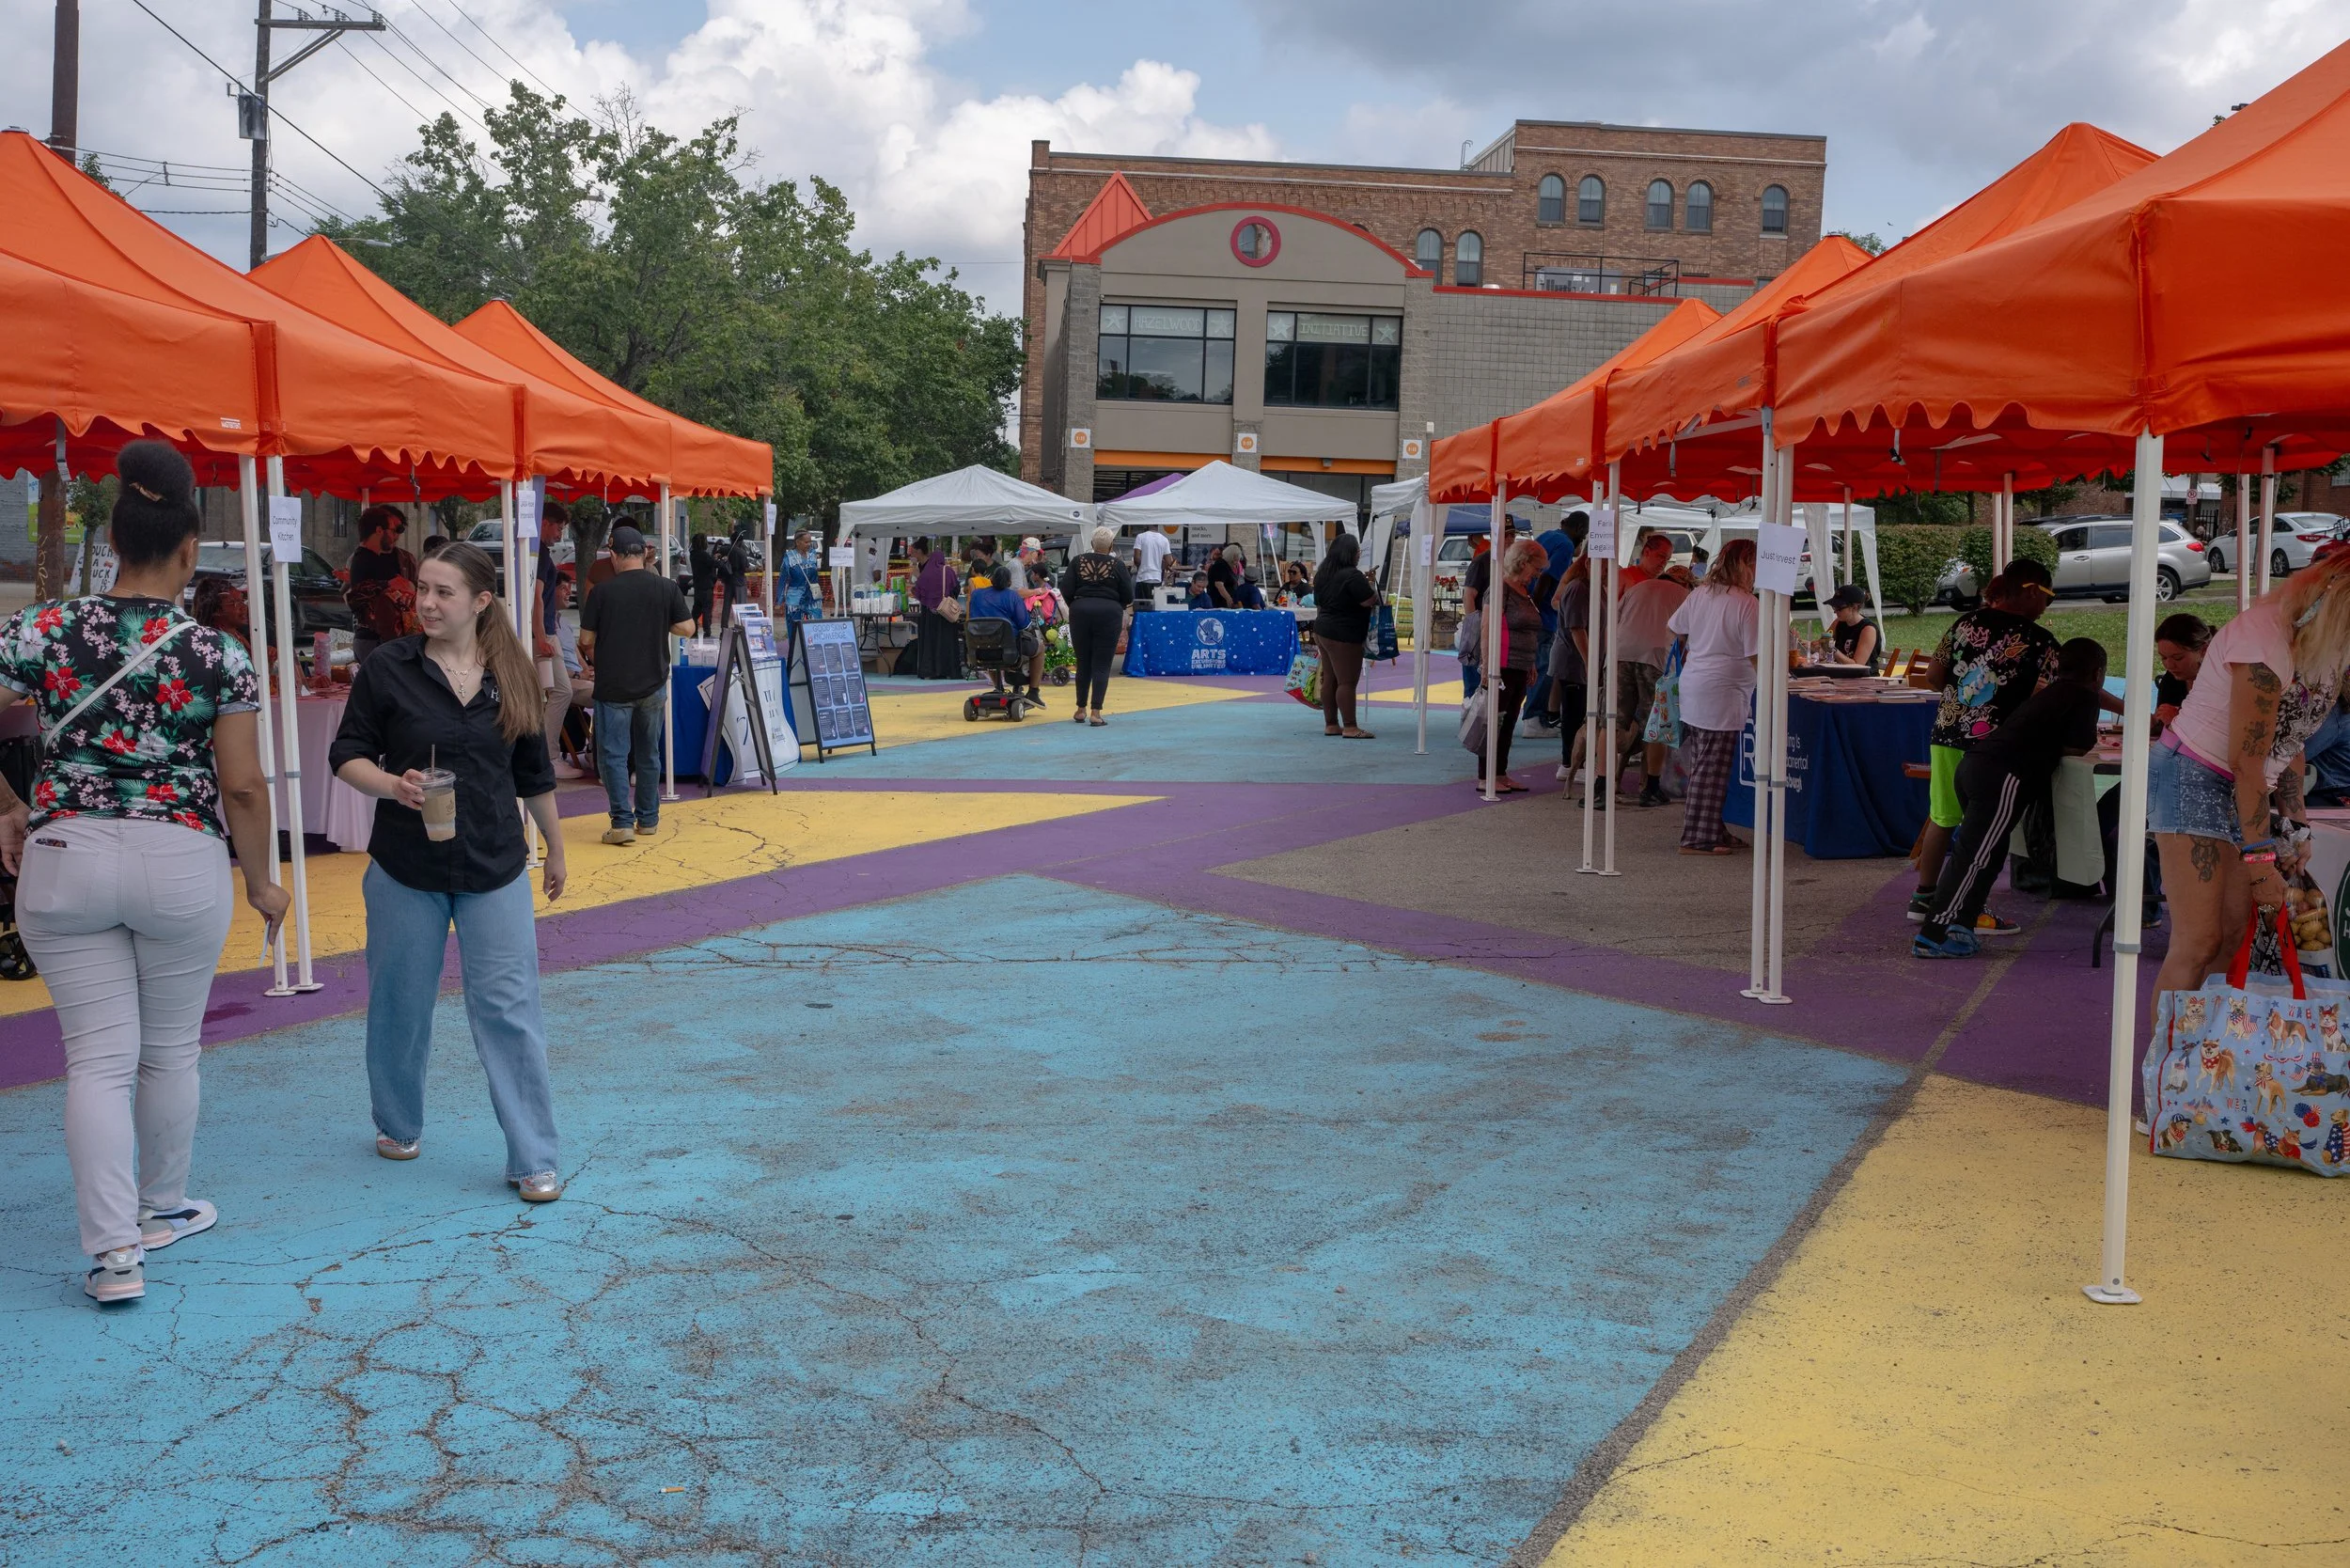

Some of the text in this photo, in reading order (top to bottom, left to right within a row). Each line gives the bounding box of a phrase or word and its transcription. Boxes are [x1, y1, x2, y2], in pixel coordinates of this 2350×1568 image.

[1134, 315, 1369, 337] HAZELWOOD INITIATIVE
[273, 516, 298, 527] Community
[278, 532, 294, 541] Kitchen
[91, 545, 113, 557] UCH
[1761, 550, 1775, 560] Just
[79, 567, 110, 578] TUCK
[1191, 649, 1227, 659] ARTS
